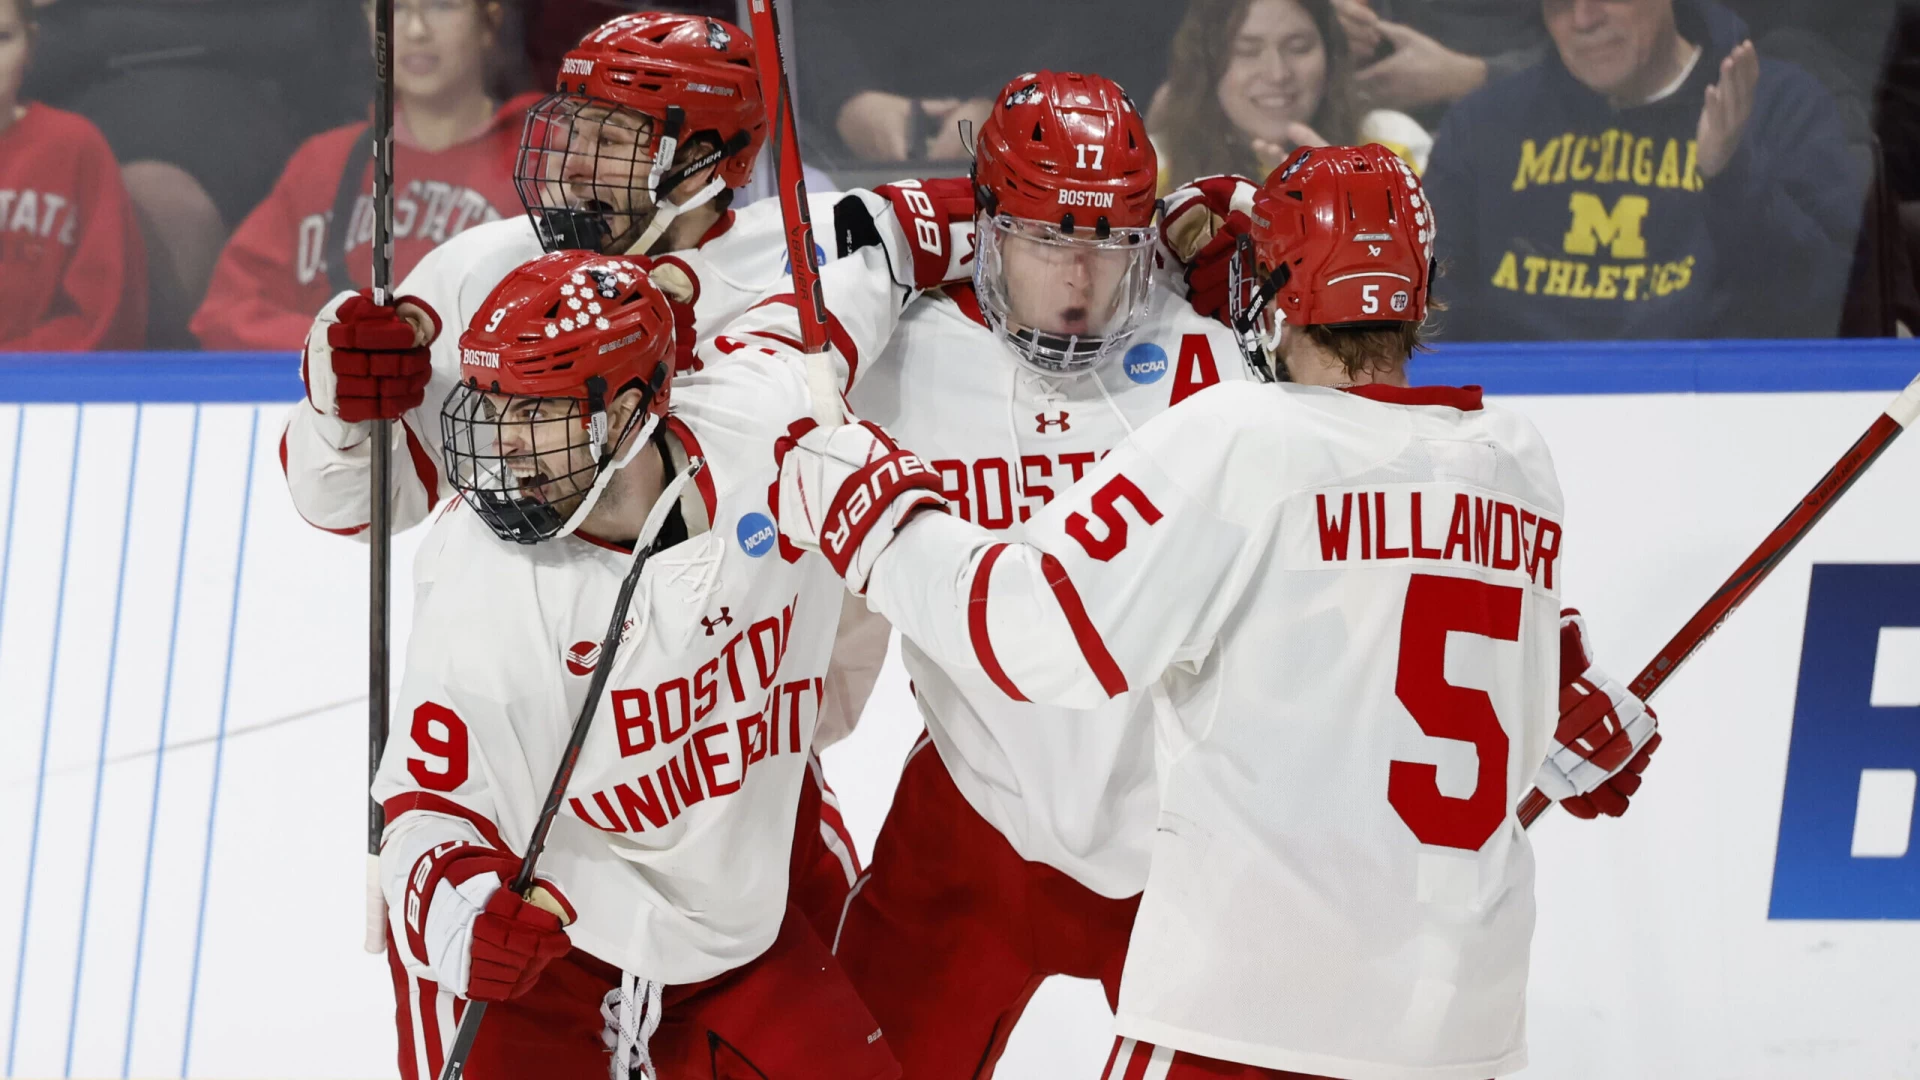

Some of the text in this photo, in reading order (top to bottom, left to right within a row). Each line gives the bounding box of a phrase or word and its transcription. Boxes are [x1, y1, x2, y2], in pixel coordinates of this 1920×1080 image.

[562, 58, 595, 76] BOSTON
[1075, 143, 1105, 170] 17
[1057, 188, 1114, 208] BOSTON
[1563, 192, 1648, 258] M
[1362, 284, 1380, 314] 5
[485, 308, 507, 333] 9
[462, 349, 500, 369] BOSTON
[1130, 360, 1166, 375] NCAA
[1168, 333, 1221, 408] A
[931, 449, 1112, 530] BOST
[1065, 473, 1164, 562] 5
[744, 526, 774, 551] NCAA
[1316, 491, 1562, 590] WILLANDER
[1388, 573, 1523, 852] 5
[407, 701, 468, 792] 9
